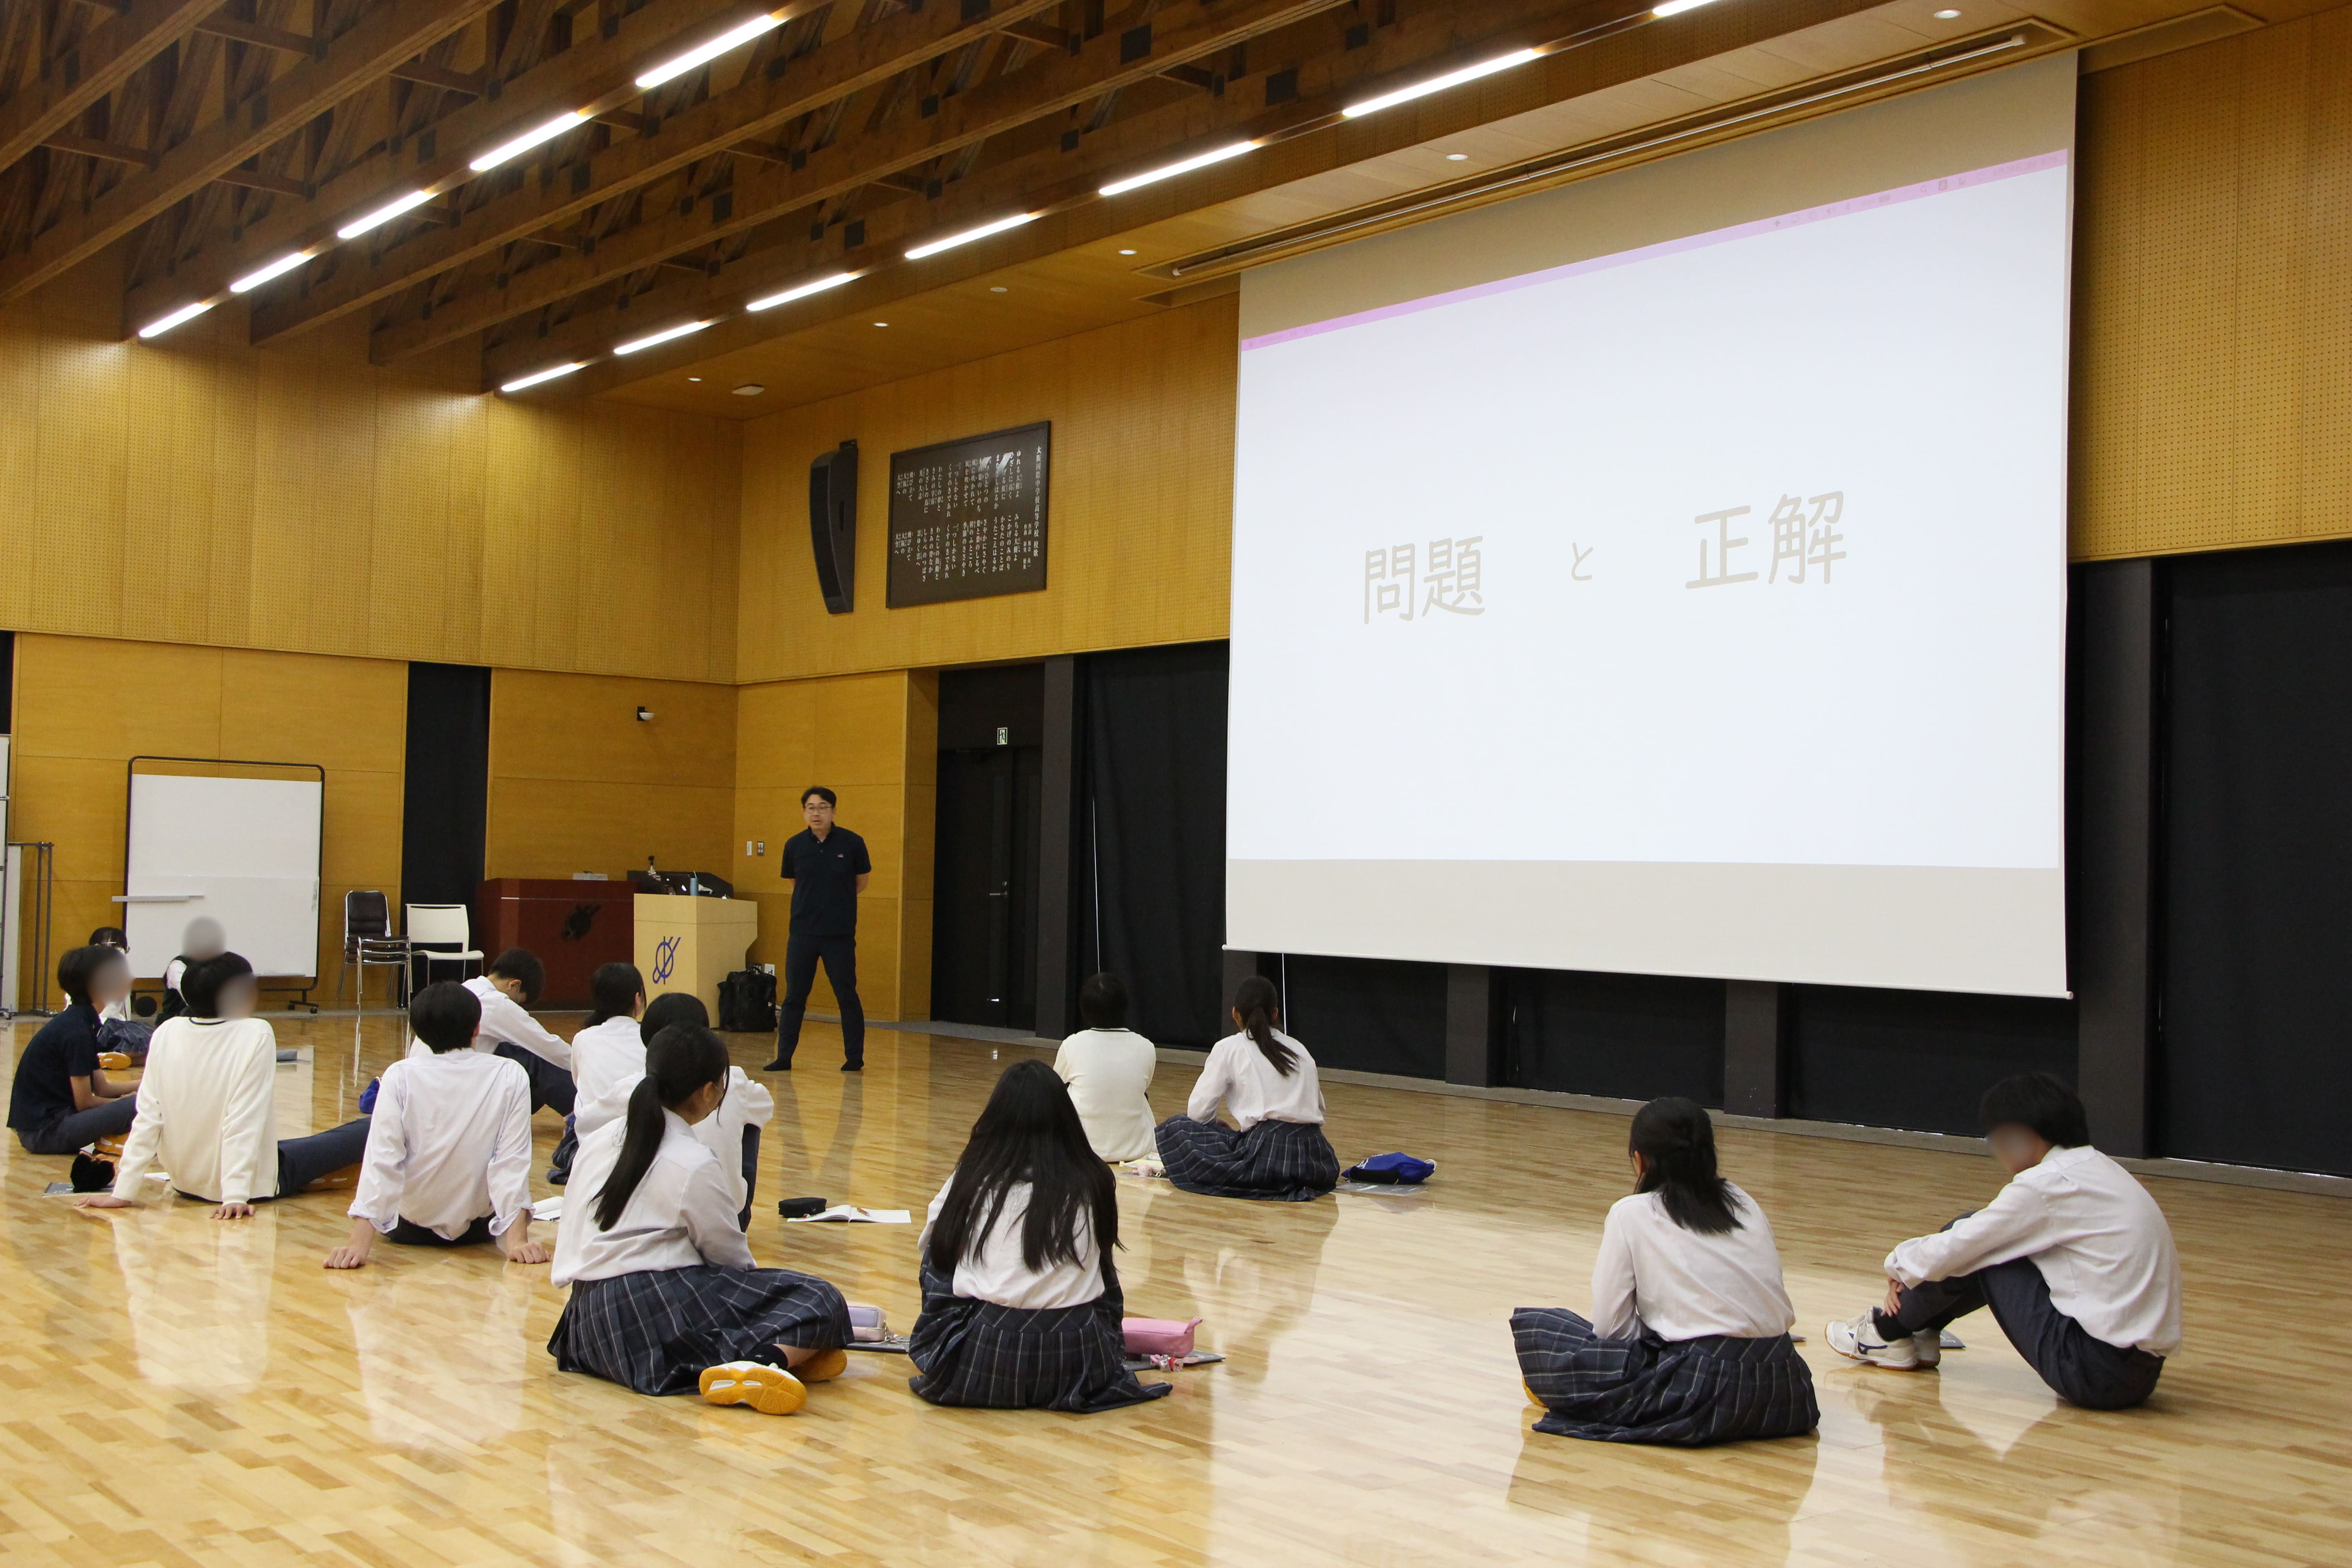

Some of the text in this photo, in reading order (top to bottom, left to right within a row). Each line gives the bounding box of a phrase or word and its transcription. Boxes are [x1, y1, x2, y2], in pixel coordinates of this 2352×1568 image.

[1034, 540, 1039, 557] 校歌
[1364, 491, 1847, 624] 問題 と 正解
